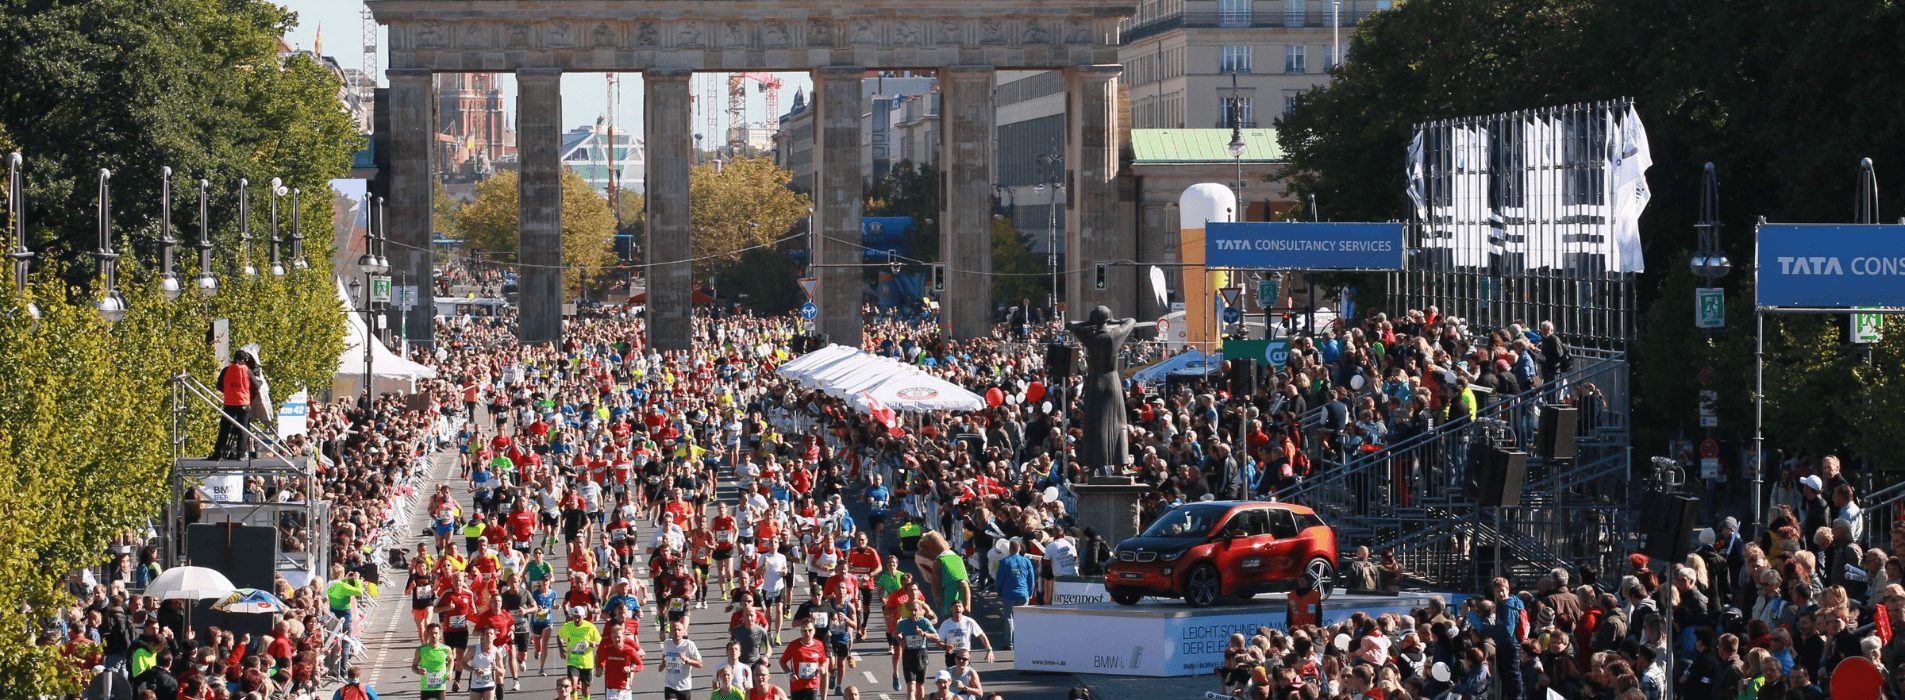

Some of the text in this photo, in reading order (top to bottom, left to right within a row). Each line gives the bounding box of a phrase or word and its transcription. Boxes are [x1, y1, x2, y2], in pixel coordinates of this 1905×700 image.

[1216, 239, 1392, 251] TATA CONSULTANCY SERVICES
[1777, 256, 1844, 275] TATA
[280, 404, 305, 415] km 42
[1052, 593, 1105, 605] orgenpost
[1183, 641, 1204, 655] DER
[1094, 655, 1119, 669] BMW
